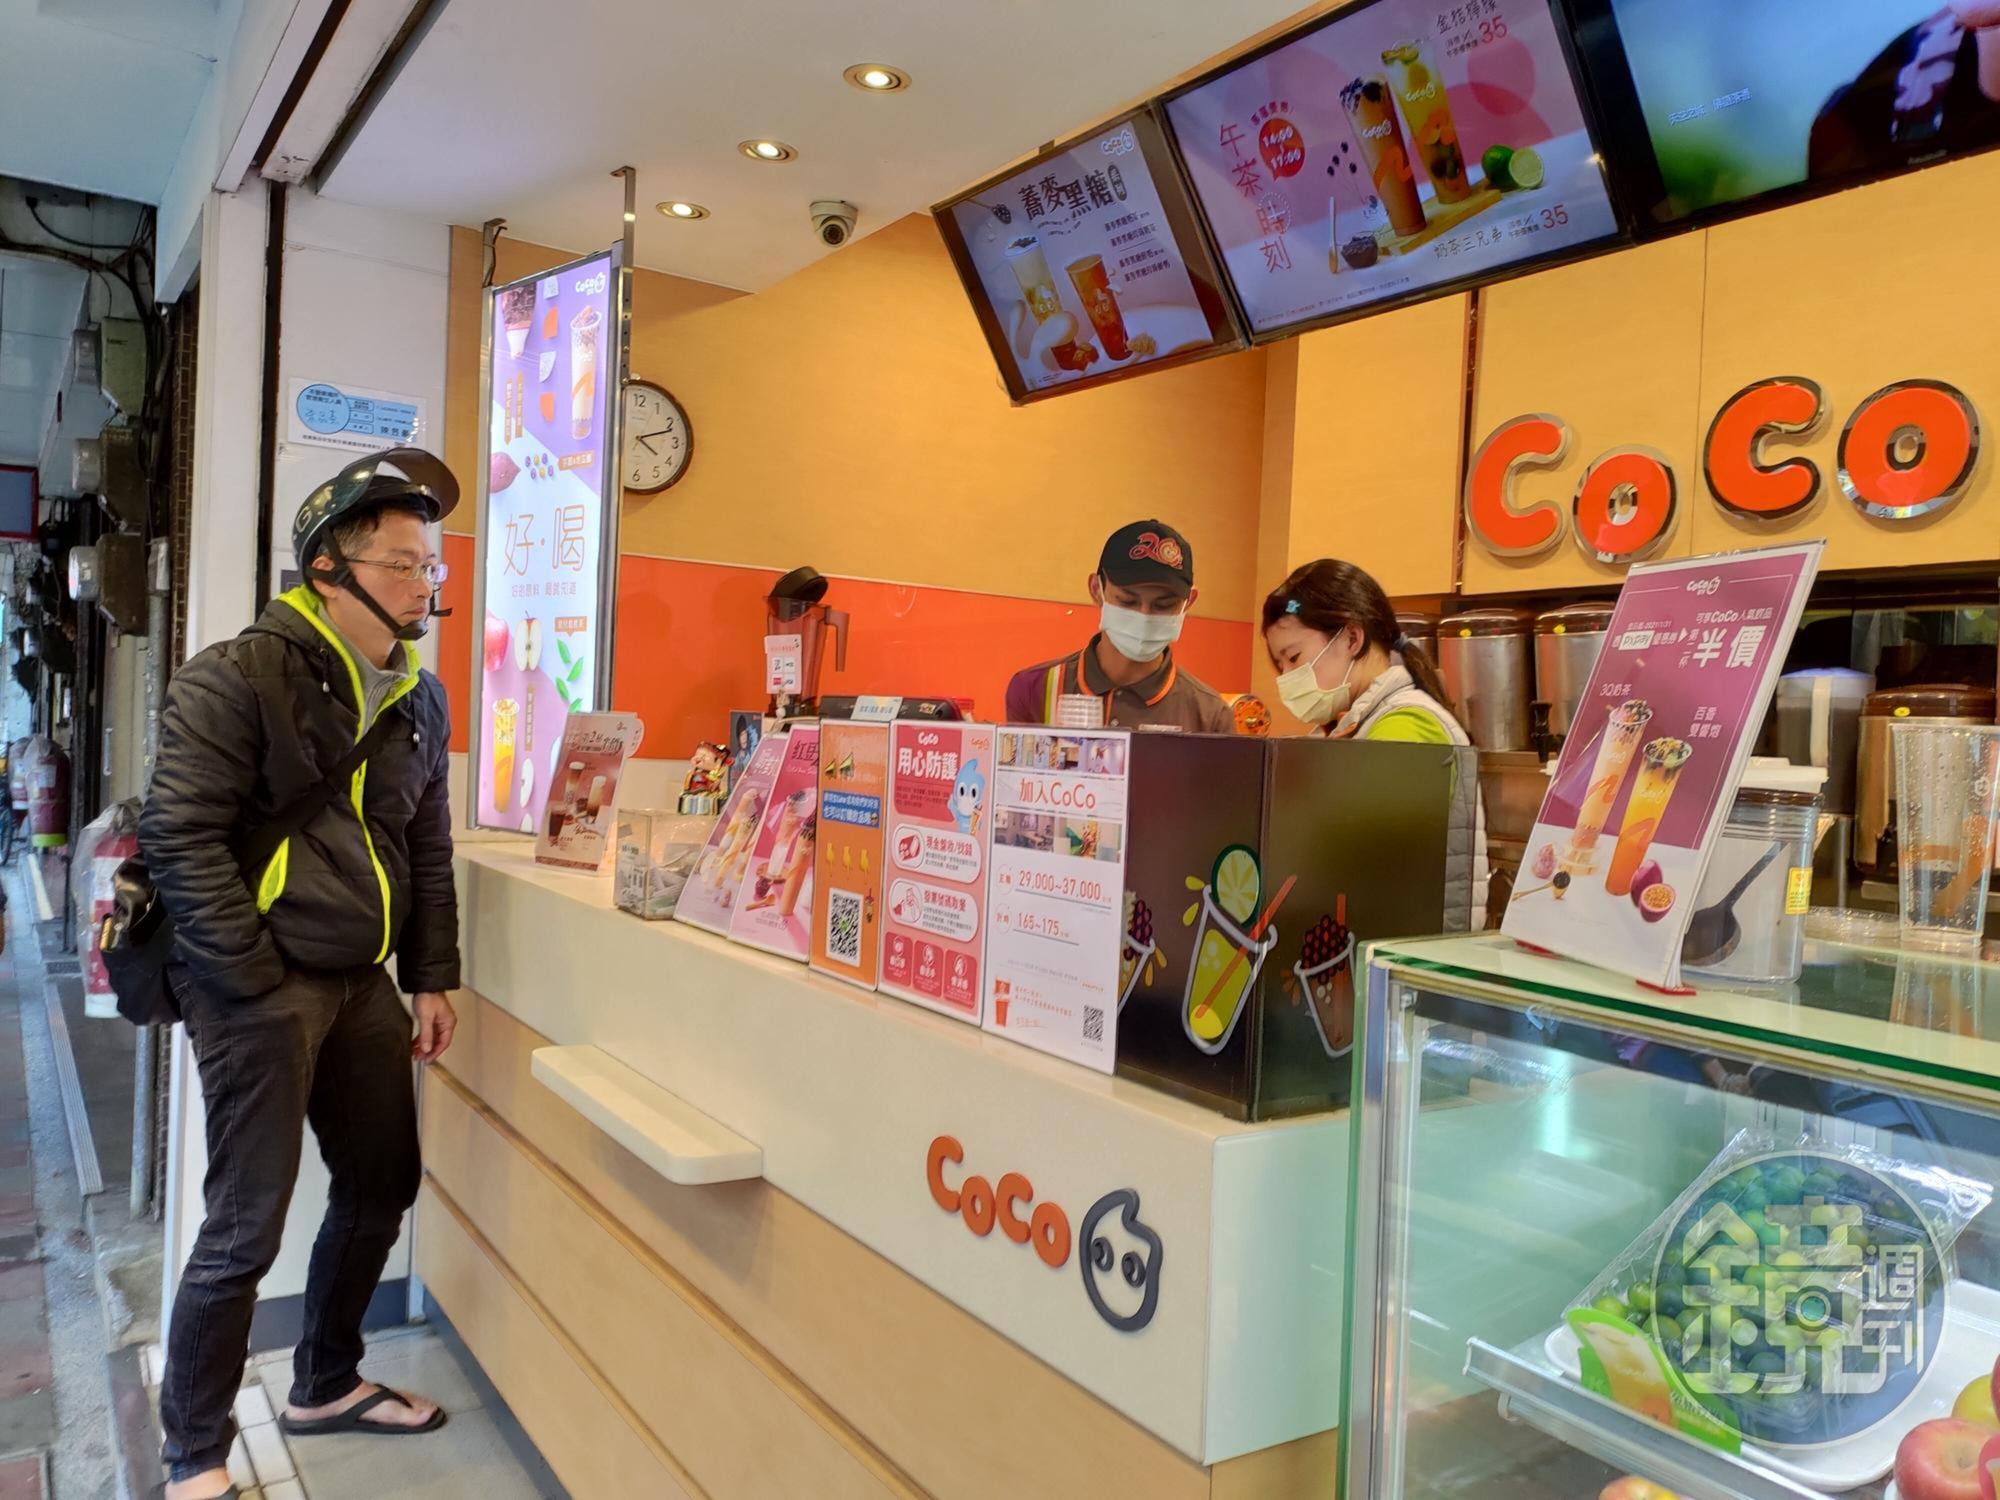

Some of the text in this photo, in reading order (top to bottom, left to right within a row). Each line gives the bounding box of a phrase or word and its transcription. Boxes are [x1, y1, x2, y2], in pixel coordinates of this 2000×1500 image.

[1479, 15, 1507, 44] 35
[1018, 169, 1114, 221] 蕎麥黑糖
[1540, 204, 1569, 229] 35
[633, 393, 647, 408] 12
[654, 402, 660, 416] 1
[666, 416, 674, 429] 2
[671, 436, 679, 450] 3
[652, 465, 661, 479] 5
[664, 455, 673, 467] 4
[1464, 375, 1983, 566] CoCo
[632, 468, 641, 482] 6
[1693, 625, 1768, 669] 半價
[918, 731, 939, 746] CoCo
[897, 746, 959, 782] 用心防護
[1019, 777, 1096, 810] 加入CoCo
[1018, 869, 1102, 901] 29,000~37,000
[1017, 912, 1060, 937] 165~175
[926, 1134, 1072, 1268] CoCo
